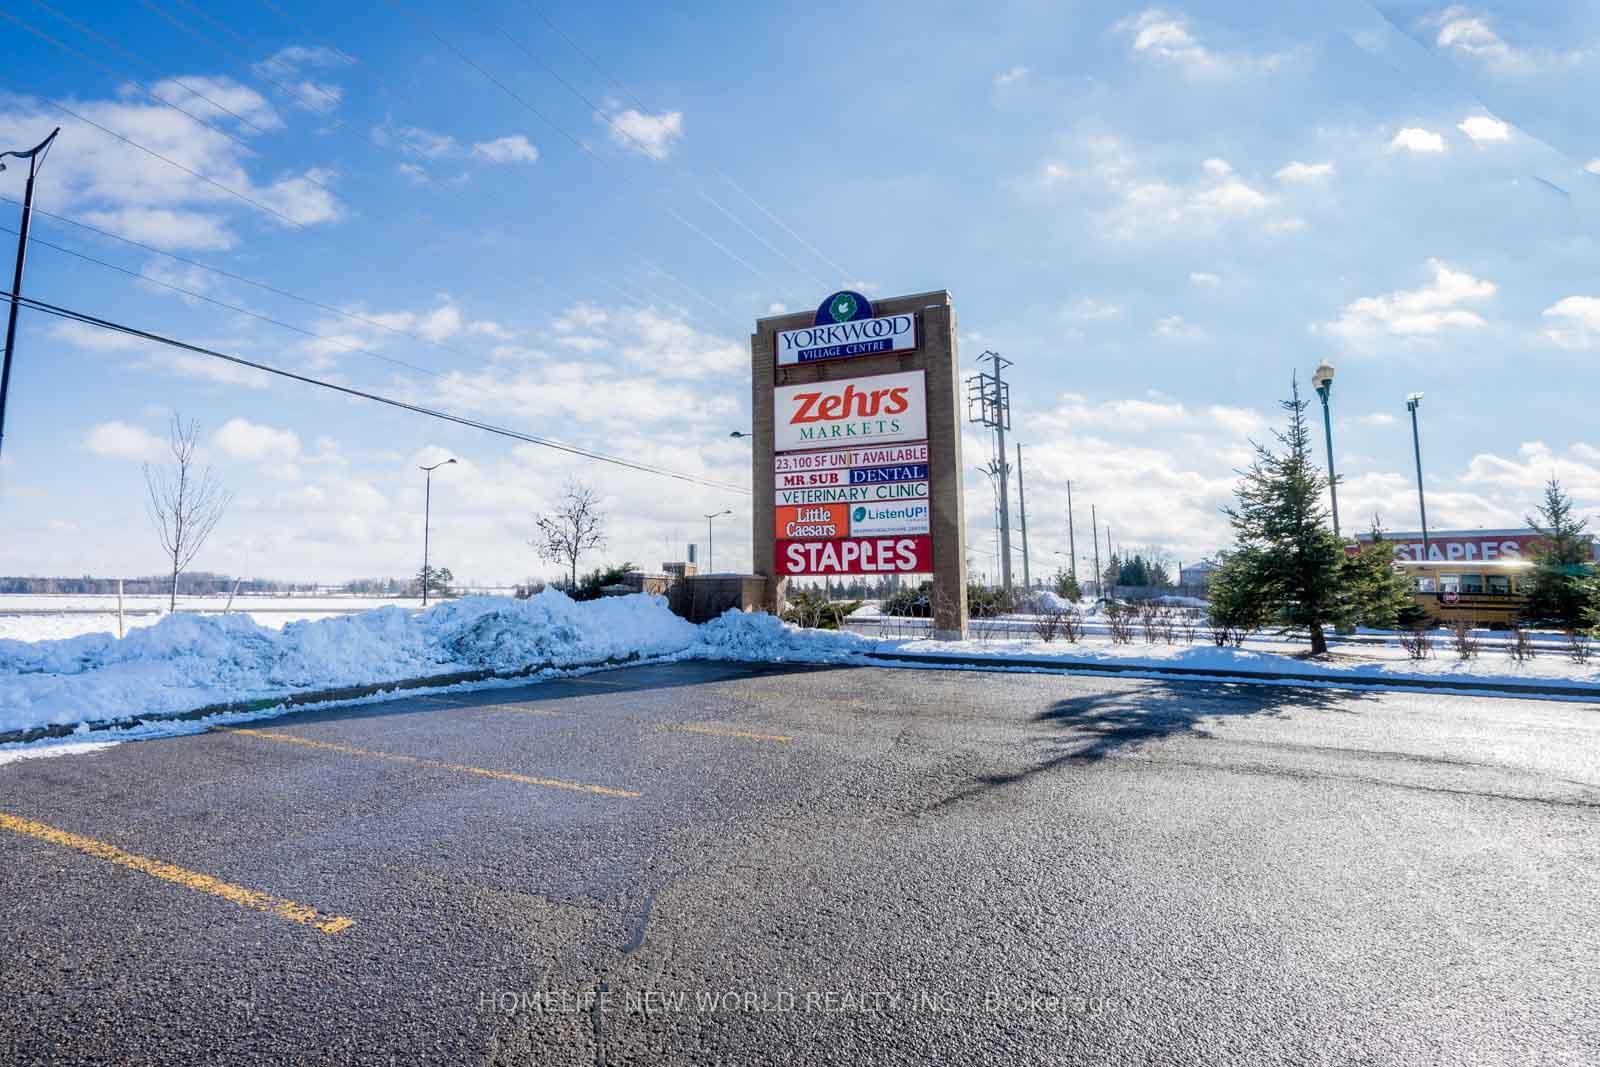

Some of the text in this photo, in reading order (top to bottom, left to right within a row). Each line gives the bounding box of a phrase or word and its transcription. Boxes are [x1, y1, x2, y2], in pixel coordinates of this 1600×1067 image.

[782, 316, 911, 349] YORKWOOD
[803, 340, 884, 360] VILLAGE CENTRE
[790, 384, 909, 424] Zehrs
[800, 419, 900, 441] MARKETS
[776, 457, 811, 471] 23,100
[814, 455, 827, 467] SF
[862, 447, 927, 464] AVAILABLE
[854, 466, 924, 483] DENTAL
[782, 483, 928, 504] VETERINARY CLINIC
[796, 507, 831, 523] Little
[786, 521, 836, 537] Caesars
[786, 539, 918, 573] STAPLES
